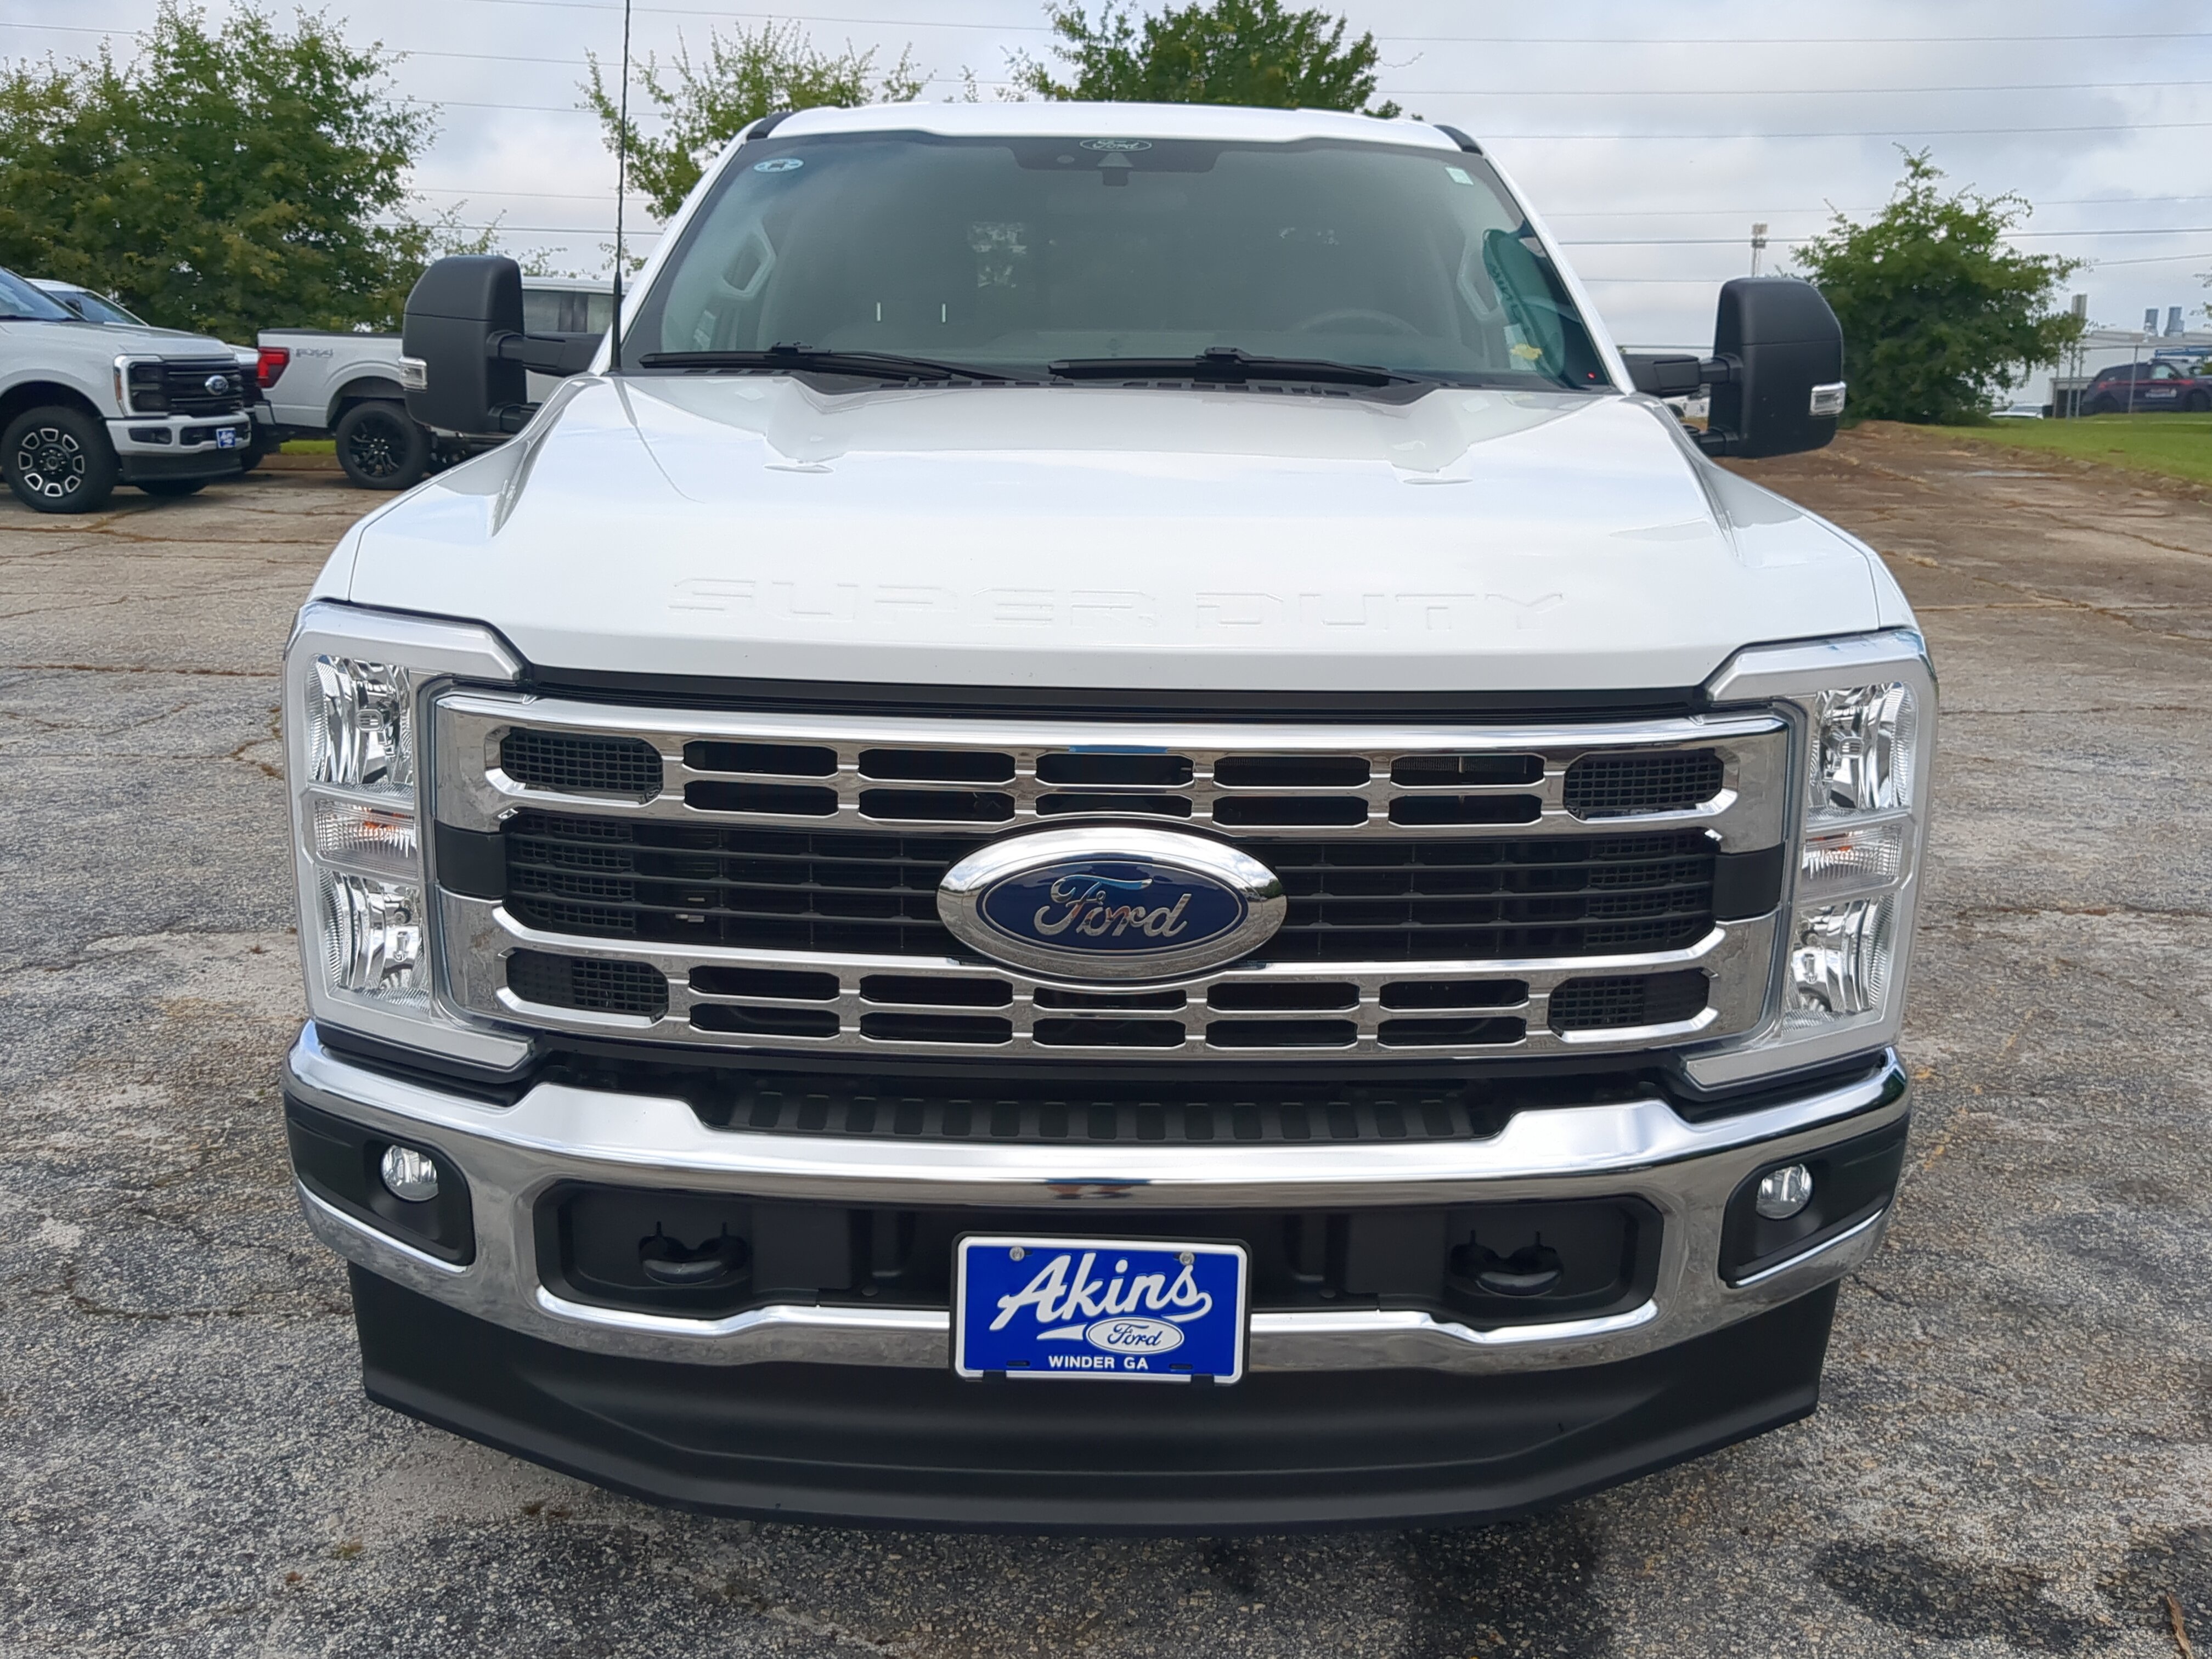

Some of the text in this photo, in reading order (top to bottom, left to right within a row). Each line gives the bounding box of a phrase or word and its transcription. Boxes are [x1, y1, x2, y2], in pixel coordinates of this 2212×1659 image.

[1092, 139, 1139, 149] Ford
[296, 348, 334, 358] FX4
[668, 577, 1565, 631] SUPER DUTY
[1034, 873, 1193, 937] Ford
[989, 1251, 1213, 1331] Akins
[1107, 1321, 1163, 1347] Ford
[1048, 1354, 1148, 1371] WINDER GA
